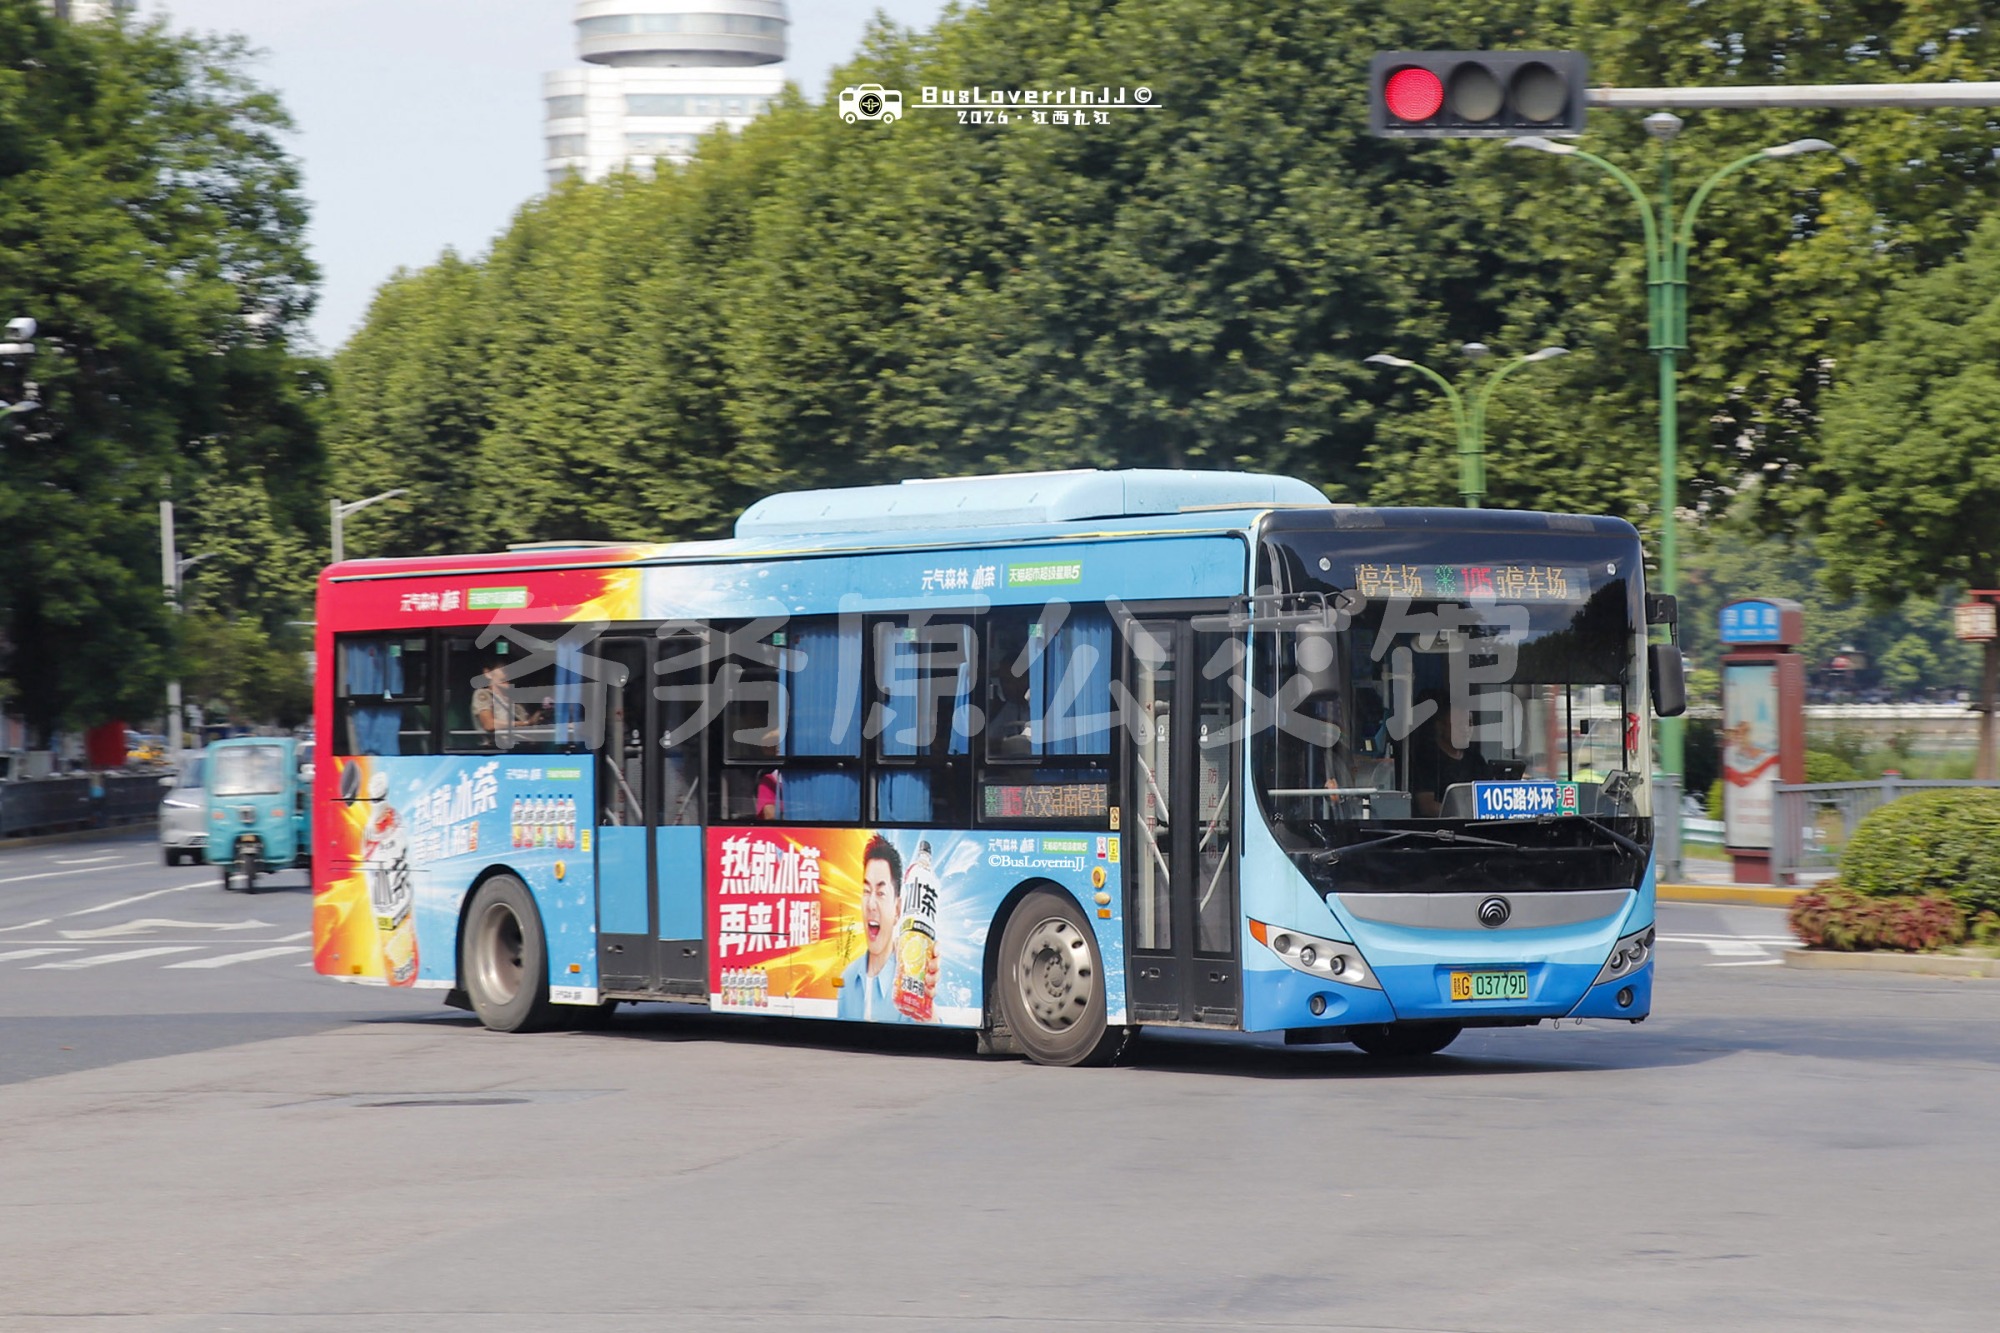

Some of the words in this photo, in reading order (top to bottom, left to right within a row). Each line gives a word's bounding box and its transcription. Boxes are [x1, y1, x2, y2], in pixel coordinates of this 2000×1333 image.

[921, 568, 968, 590] 元气森林
[1355, 564, 1423, 597] 停车场
[1461, 567, 1493, 597] 105
[1483, 786, 1555, 811] 105路外环
[719, 832, 821, 895] 热就冰茶
[719, 898, 811, 958] 再来1瓶
[1476, 974, 1527, 996] 03779D
